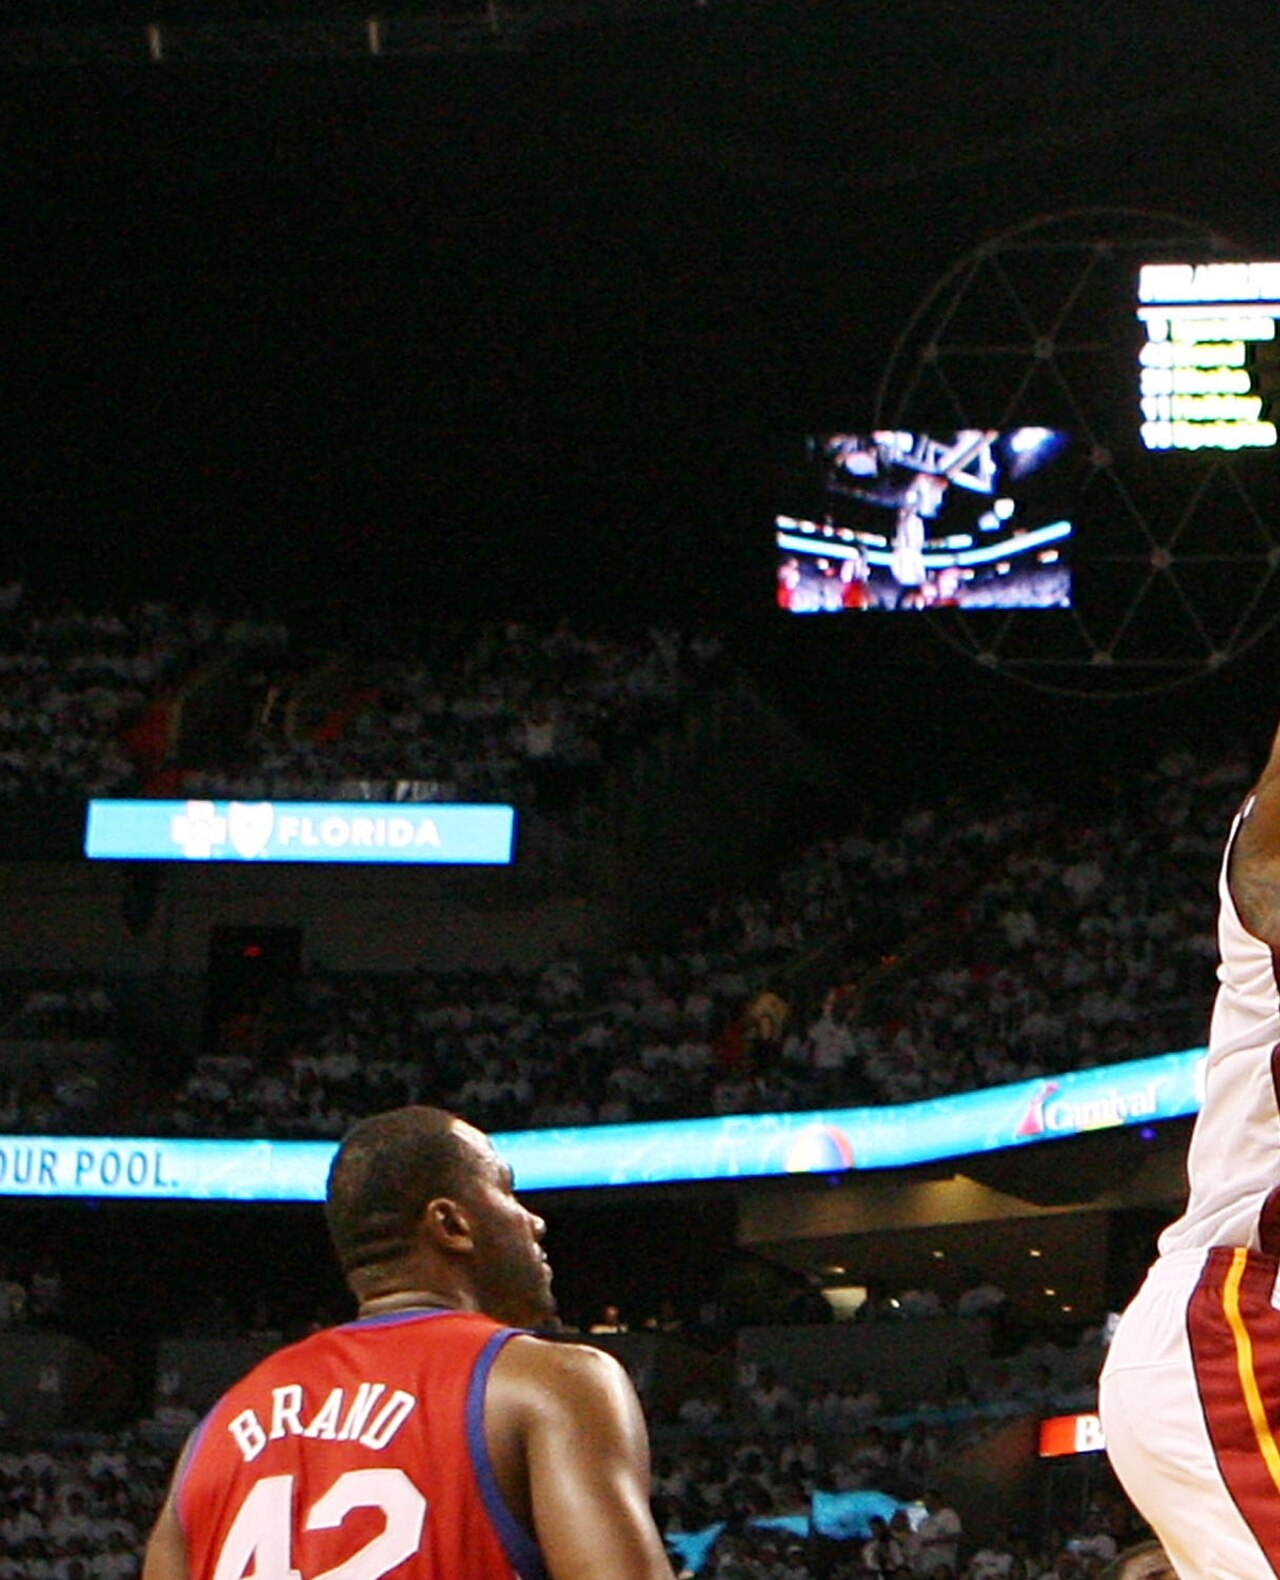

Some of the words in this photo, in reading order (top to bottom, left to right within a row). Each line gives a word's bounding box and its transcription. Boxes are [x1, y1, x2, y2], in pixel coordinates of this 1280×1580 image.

[278, 815, 441, 848] FLORIDA
[75, 1149, 179, 1188] POOL.
[228, 1383, 416, 1462] BRAND
[1075, 1415, 1105, 1452] B
